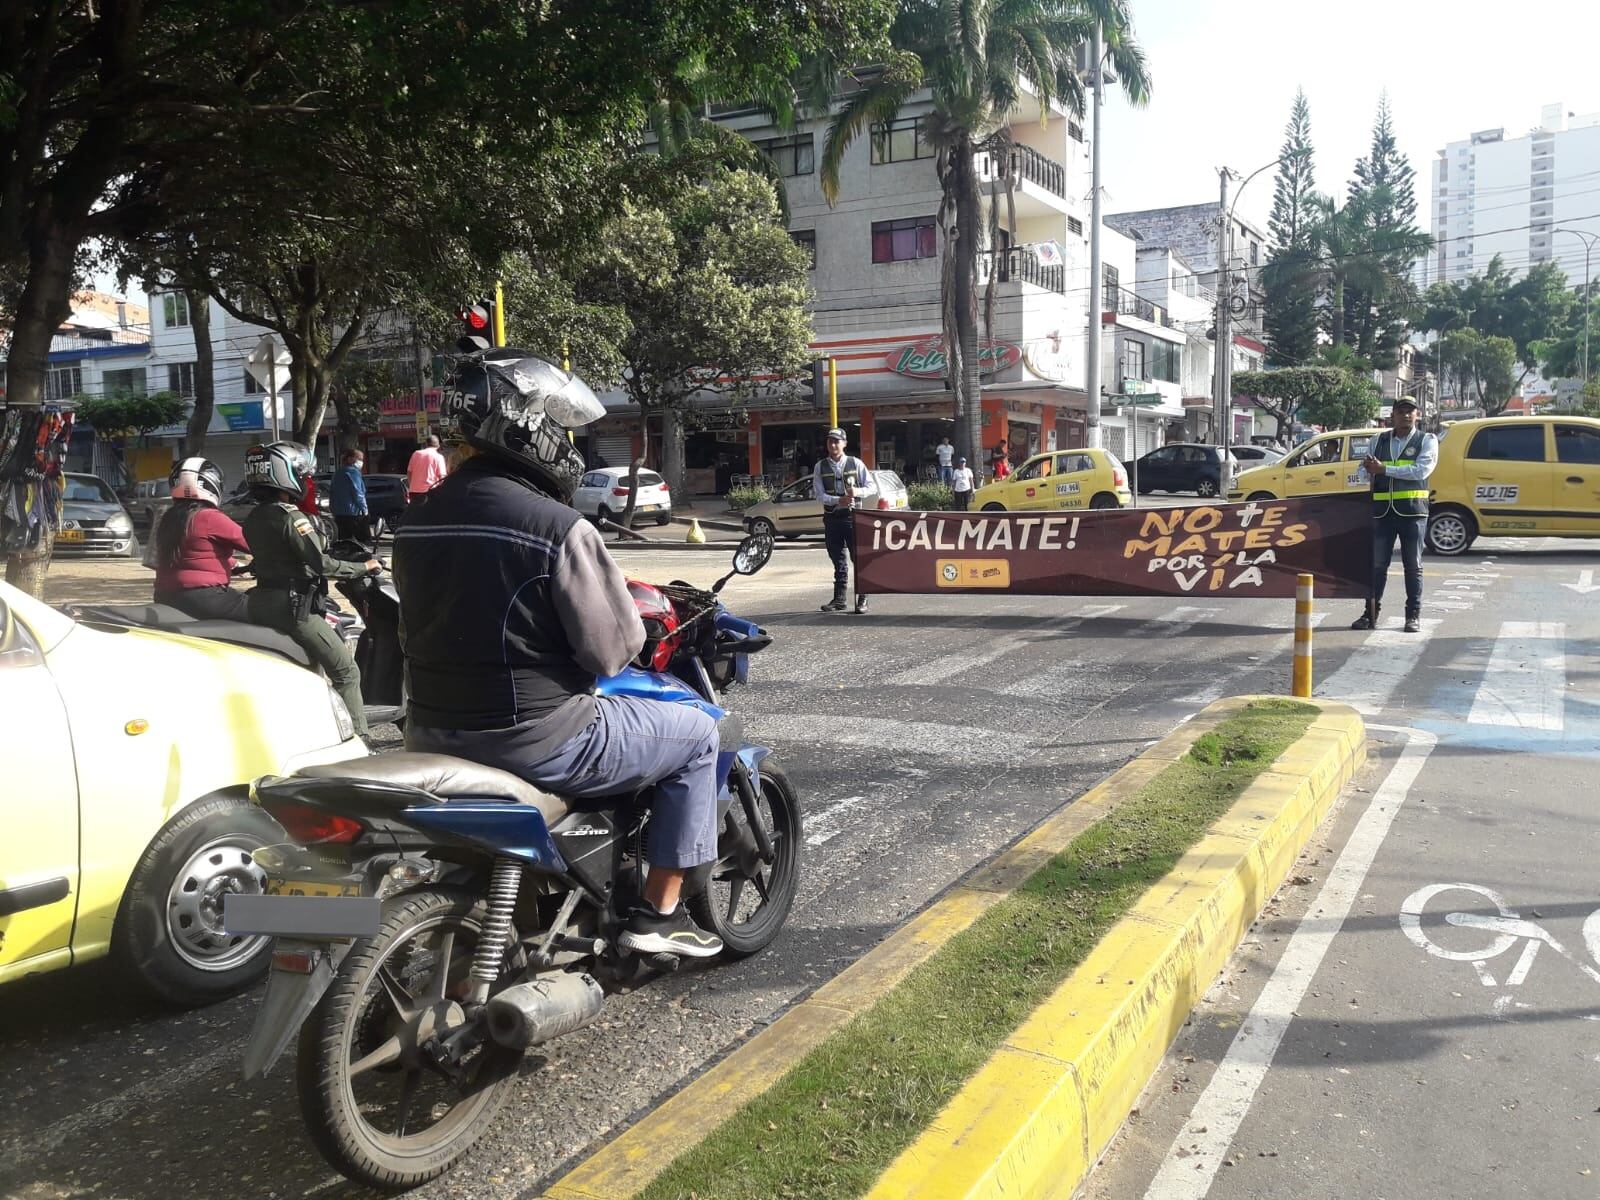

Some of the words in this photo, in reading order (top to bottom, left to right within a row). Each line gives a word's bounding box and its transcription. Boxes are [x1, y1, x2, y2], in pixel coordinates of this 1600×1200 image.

[872, 512, 1080, 551] ¡CÁLMATE!
[1139, 506, 1223, 537] NO
[1123, 524, 1308, 558] MATES
[1147, 554, 1205, 572] POR
[1236, 549, 1277, 566] LA
[319, 856, 348, 865] HONDA
